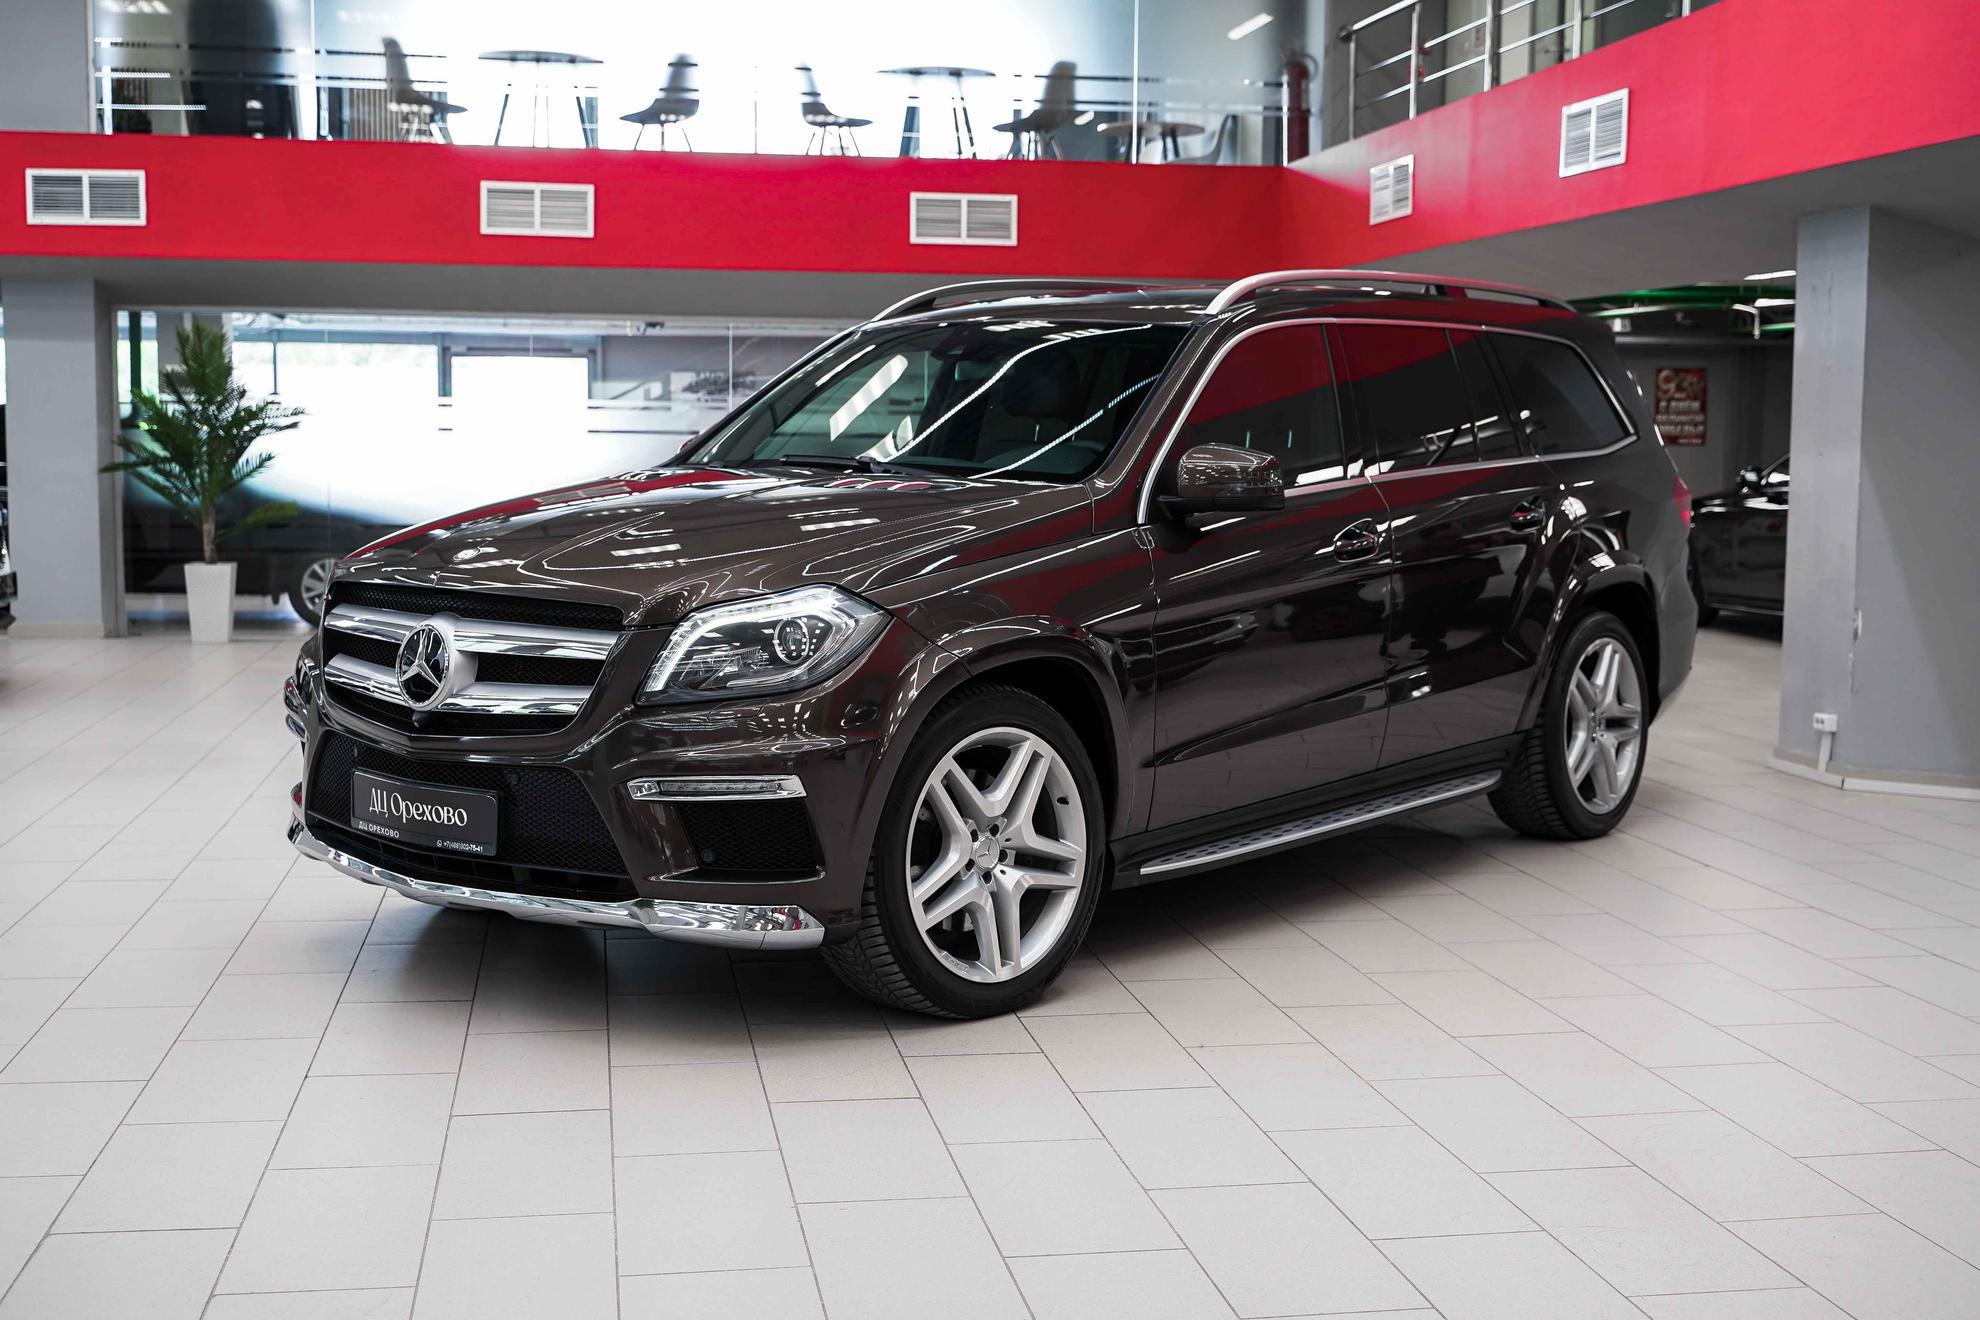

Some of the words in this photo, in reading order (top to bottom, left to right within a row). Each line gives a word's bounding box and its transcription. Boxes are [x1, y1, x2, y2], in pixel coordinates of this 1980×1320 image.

[369, 787, 388, 818] ДЦ
[390, 792, 468, 827] Орехово
[368, 823, 400, 839] ОРЕХОВО
